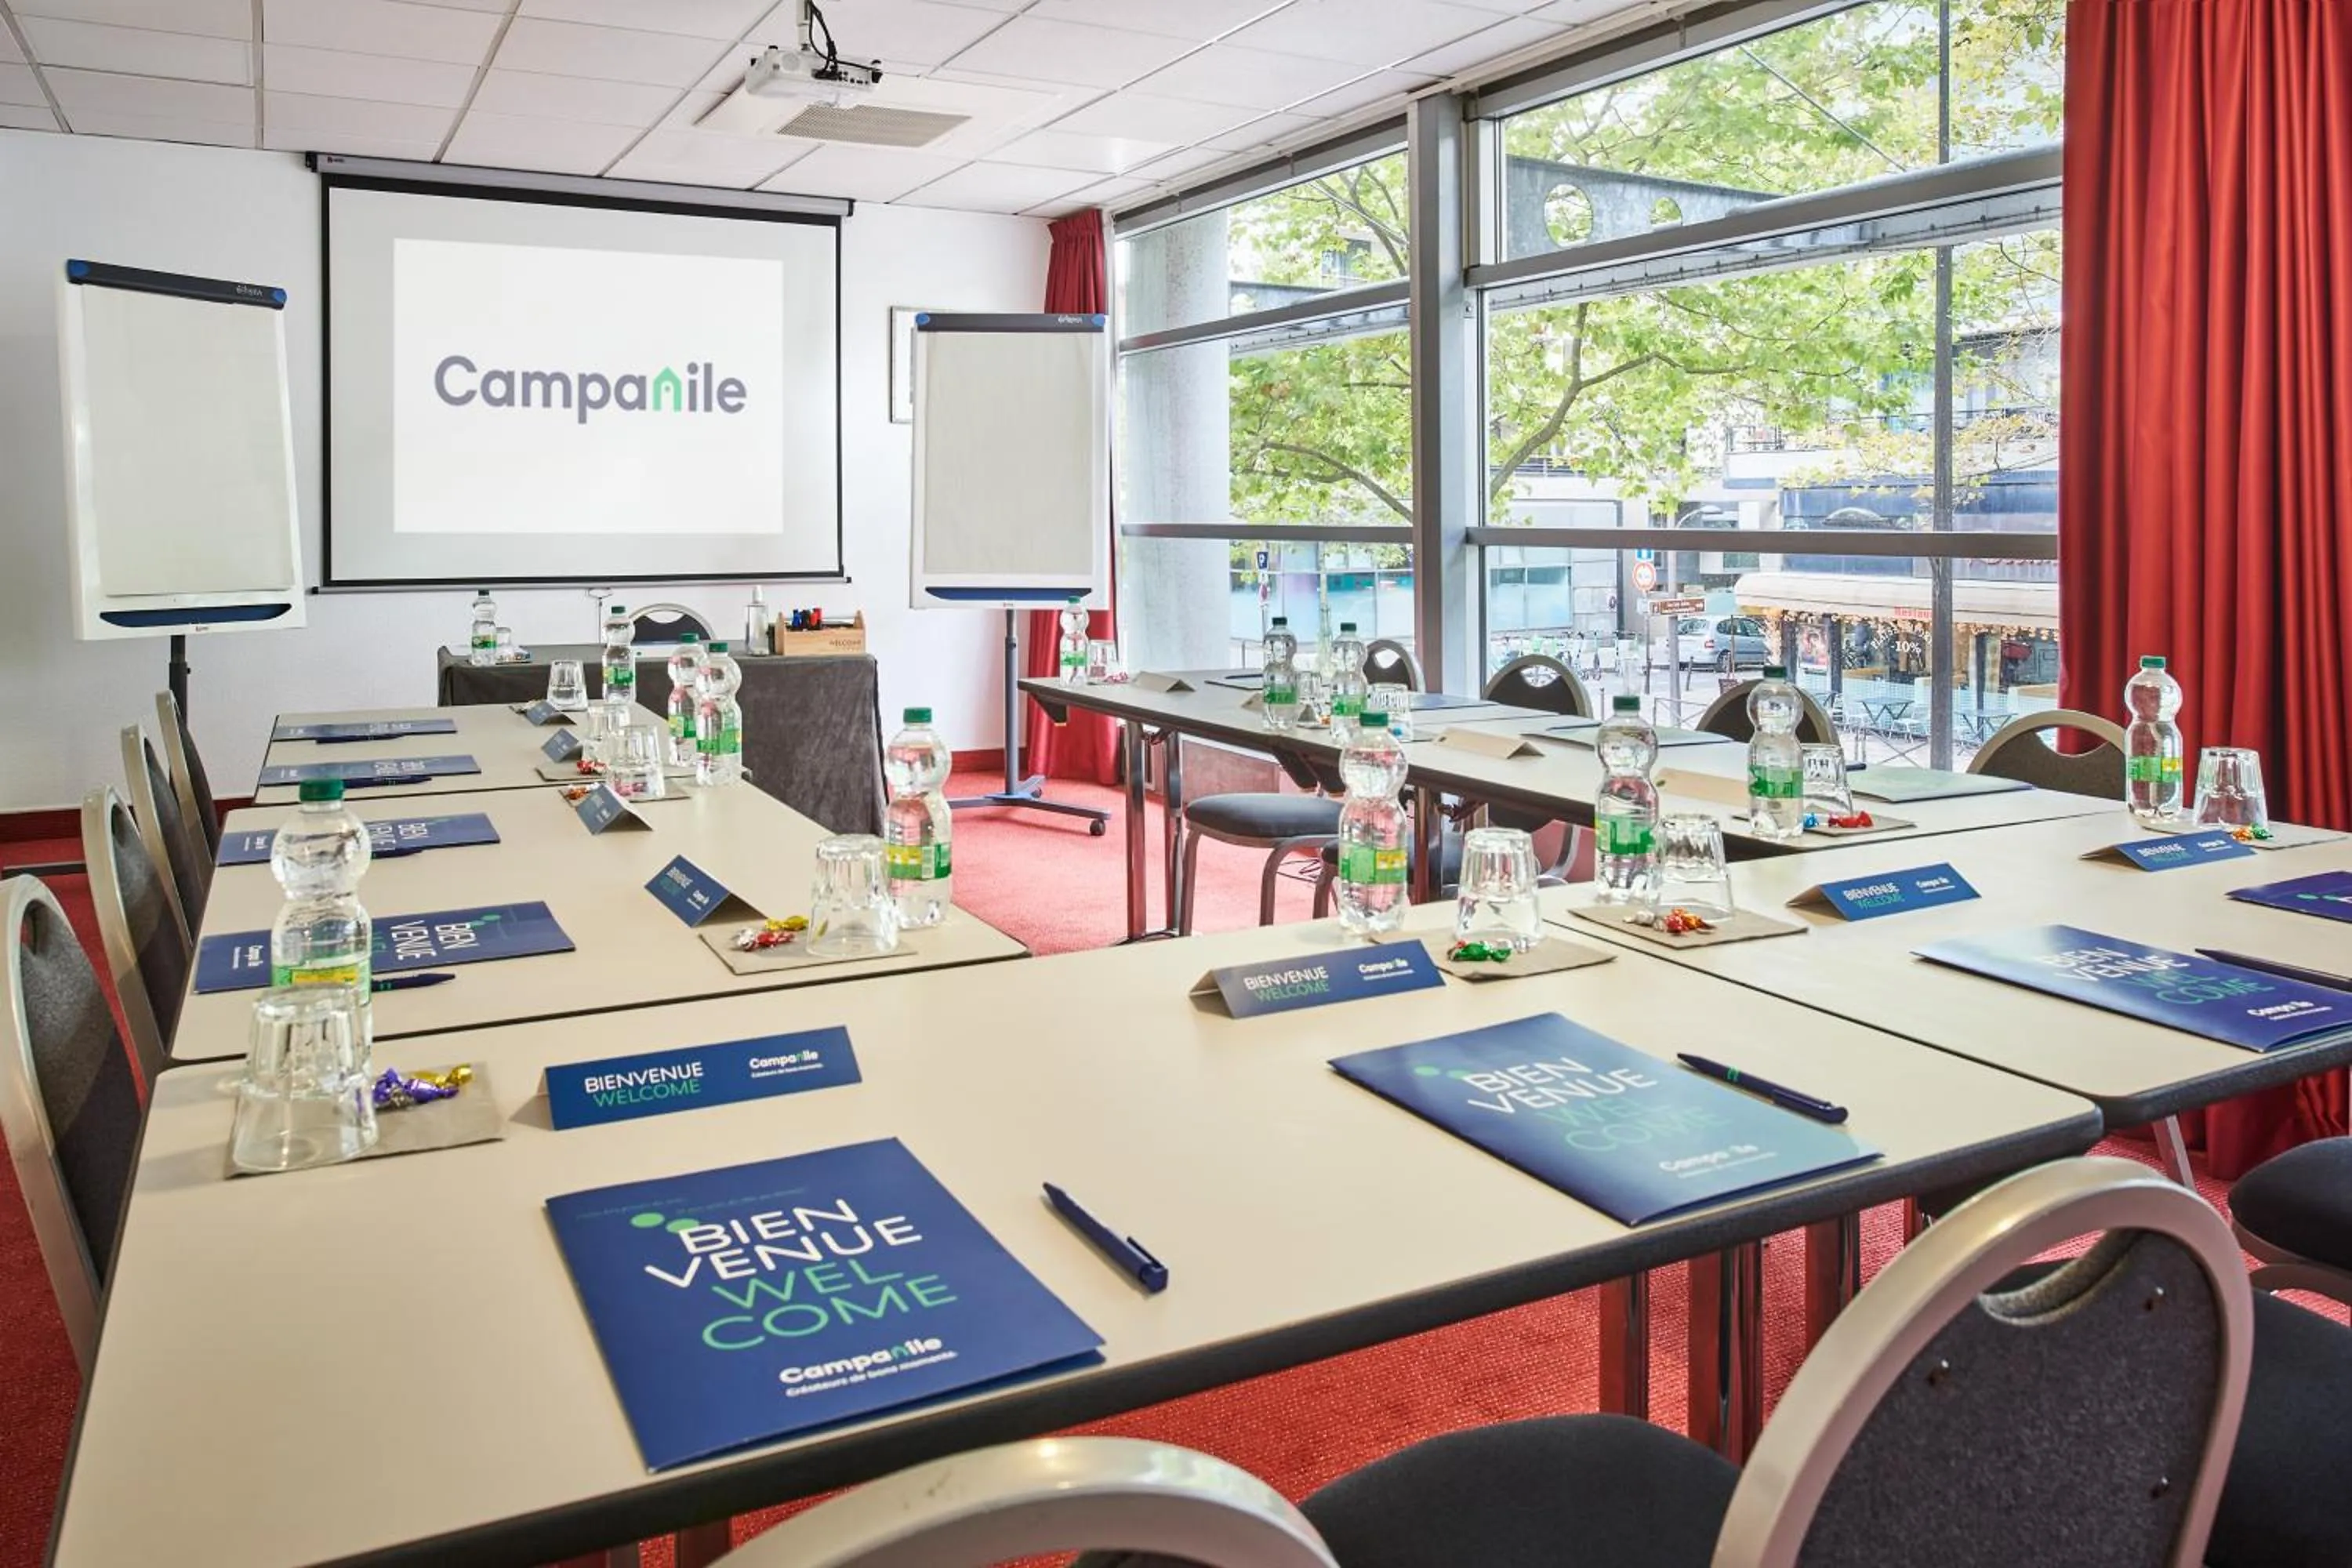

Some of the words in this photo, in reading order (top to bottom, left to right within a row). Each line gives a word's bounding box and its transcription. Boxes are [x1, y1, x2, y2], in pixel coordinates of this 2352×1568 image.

[434, 355, 746, 424] Campanile
[1890, 641, 1922, 655] -10%
[390, 919, 437, 960] VENUE
[434, 922, 481, 950] BIEN
[1243, 965, 1329, 991] BIENVENUE
[2053, 956, 2191, 982] VENUE
[1254, 980, 1330, 1004] WELCOME
[583, 1061, 704, 1094] BIENVENUE
[593, 1080, 702, 1108] WELCOME
[1463, 1056, 1595, 1095] BIEN
[1466, 1067, 1658, 1116] VENUE
[1534, 1094, 1672, 1130] WEL
[1563, 1104, 1735, 1153] COME
[679, 1198, 858, 1254] BIEN
[644, 1215, 922, 1289] VENUE
[711, 1258, 904, 1309] WEL
[702, 1274, 959, 1350] COME
[779, 1337, 943, 1385] Campanile
